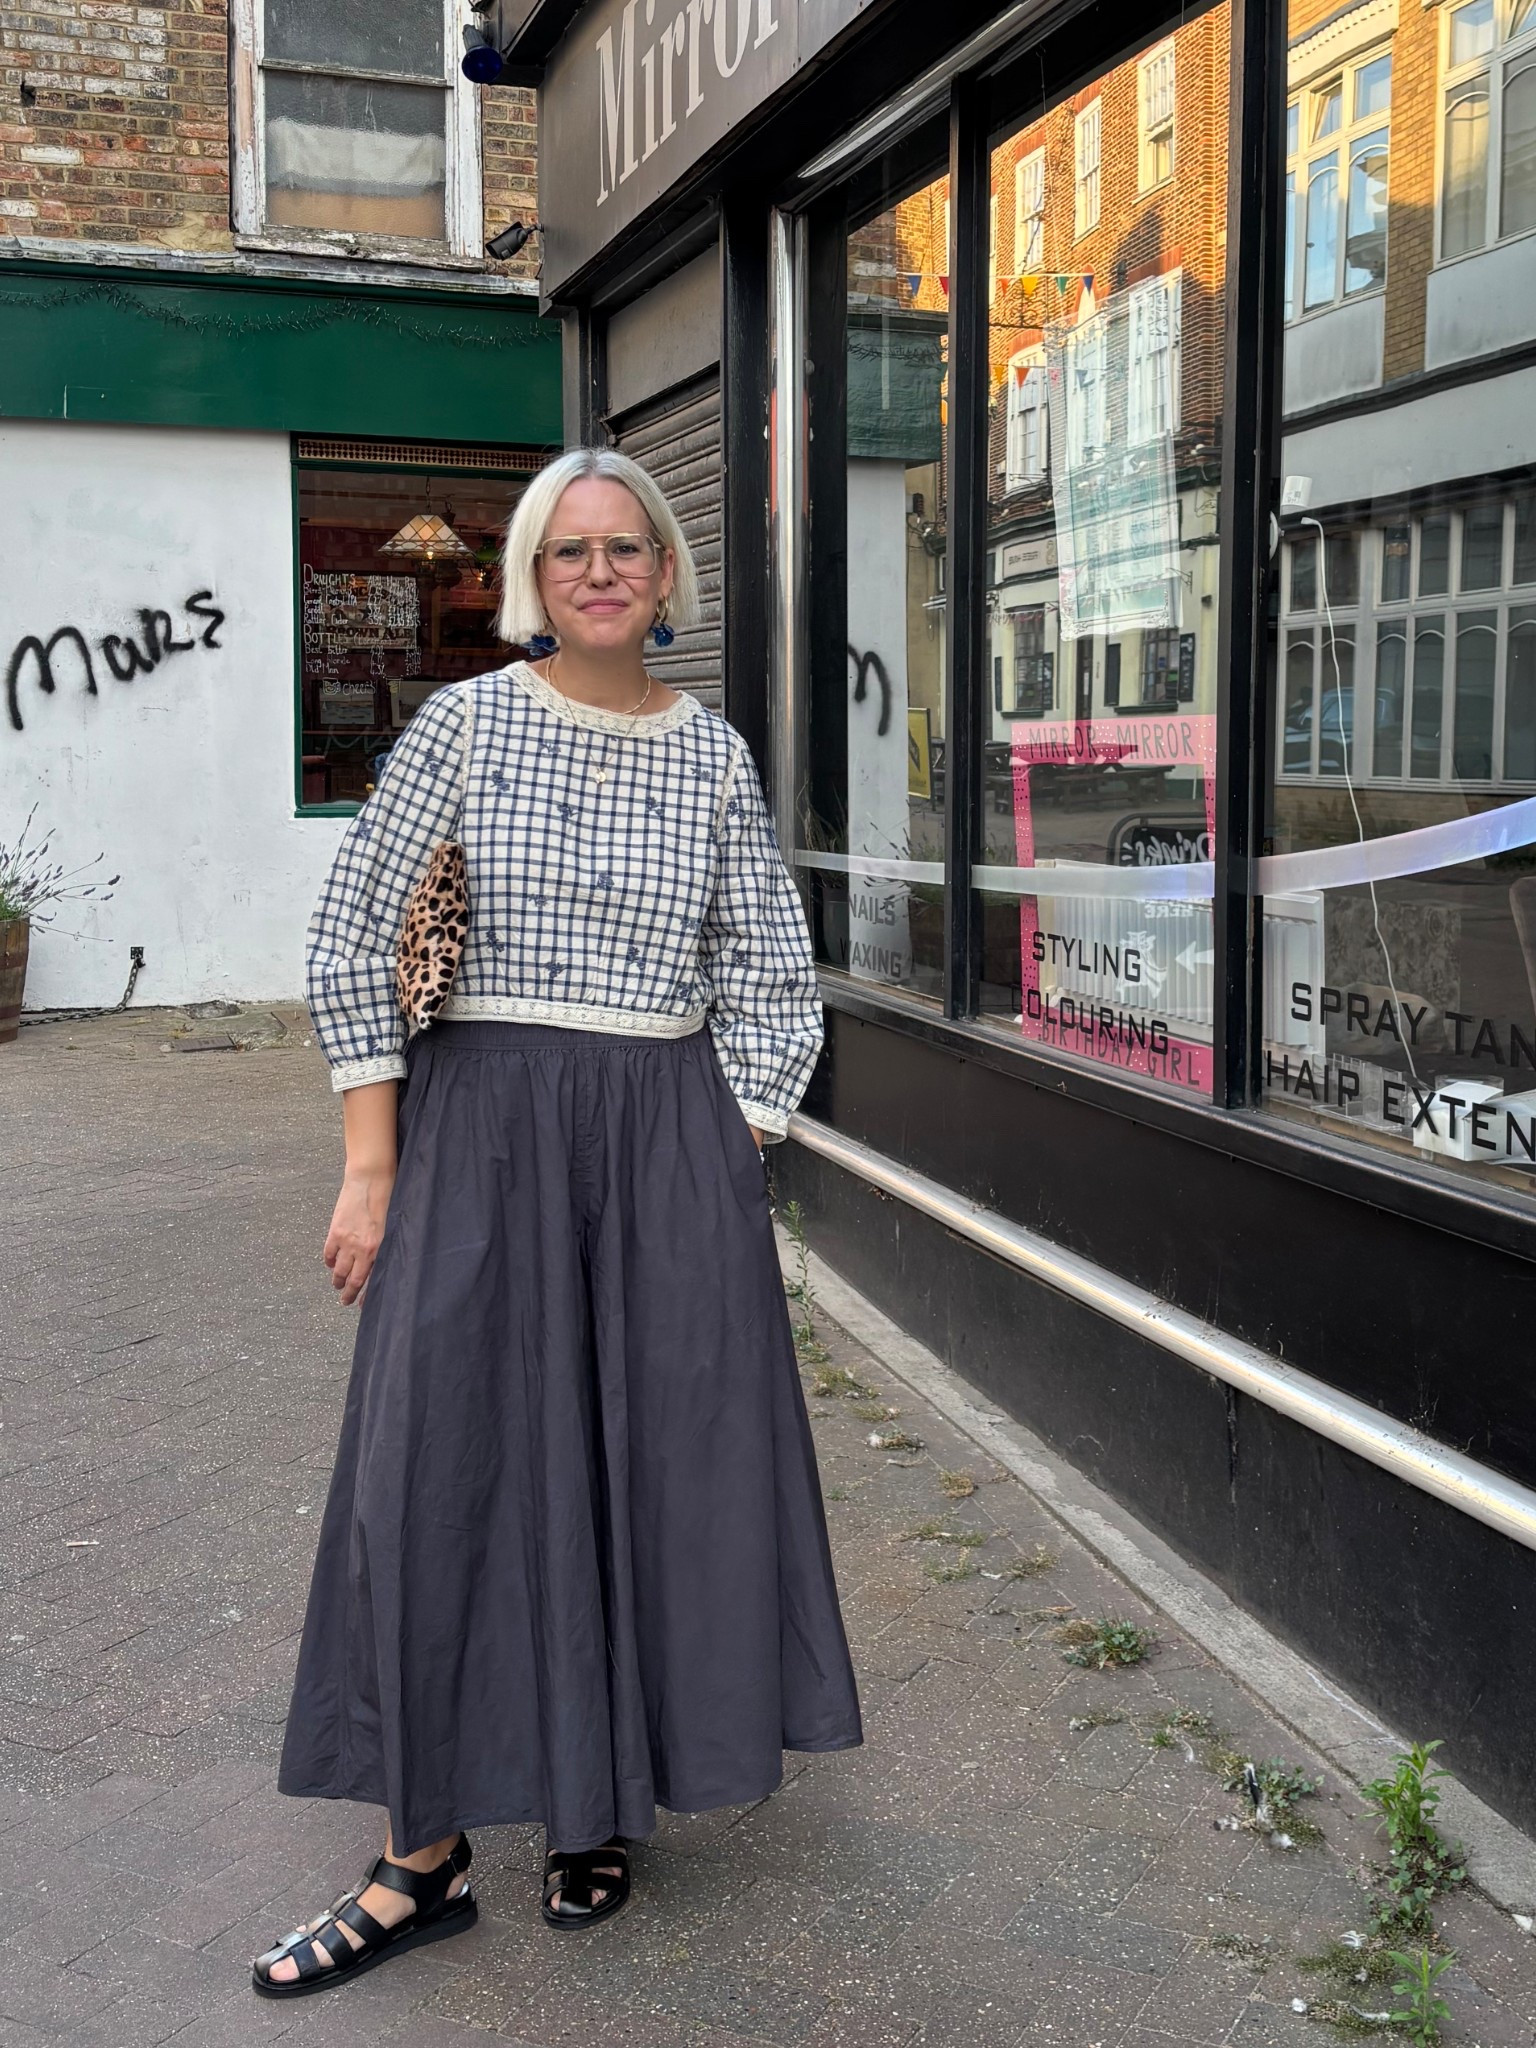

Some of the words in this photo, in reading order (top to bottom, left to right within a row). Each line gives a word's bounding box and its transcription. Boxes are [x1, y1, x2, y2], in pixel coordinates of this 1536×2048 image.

[1029, 725, 1098, 759] MIRROR
[1116, 722, 1194, 760] MIRROR
[848, 893, 895, 927] NAILS
[1032, 931, 1141, 983] STYLING
[1291, 982, 1428, 1046] SPRAY
[1445, 1011, 1536, 1072] TAN
[1147, 1042, 1200, 1087] GIRL
